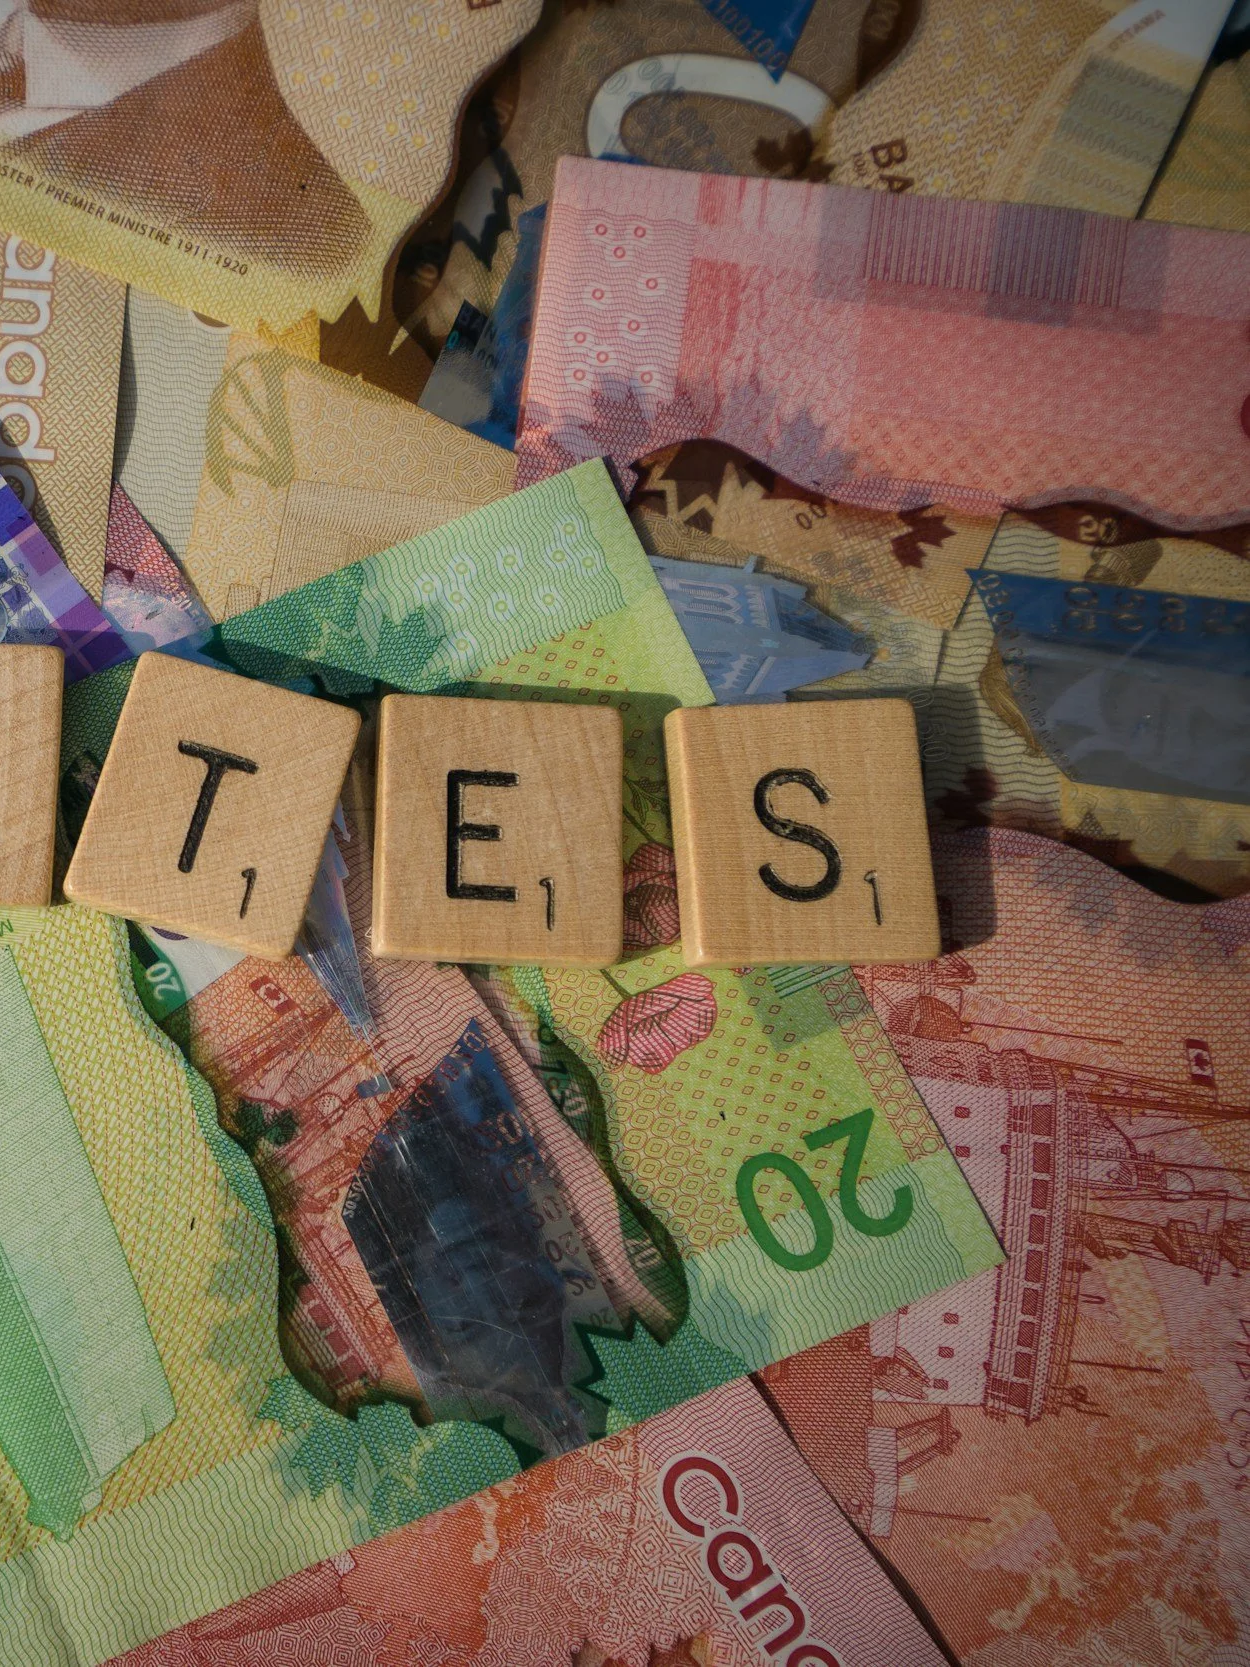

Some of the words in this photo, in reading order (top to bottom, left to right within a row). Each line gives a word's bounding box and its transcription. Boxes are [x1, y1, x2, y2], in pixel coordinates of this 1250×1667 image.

[44, 183, 106, 218] PREMIER
[107, 209, 172, 246] MINISTRE
[176, 238, 249, 277] 1911-1920
[239, 867, 258, 920] 1
[539, 876, 555, 931] 1
[863, 869, 884, 926] 1
[735, 1108, 914, 1273] 20
